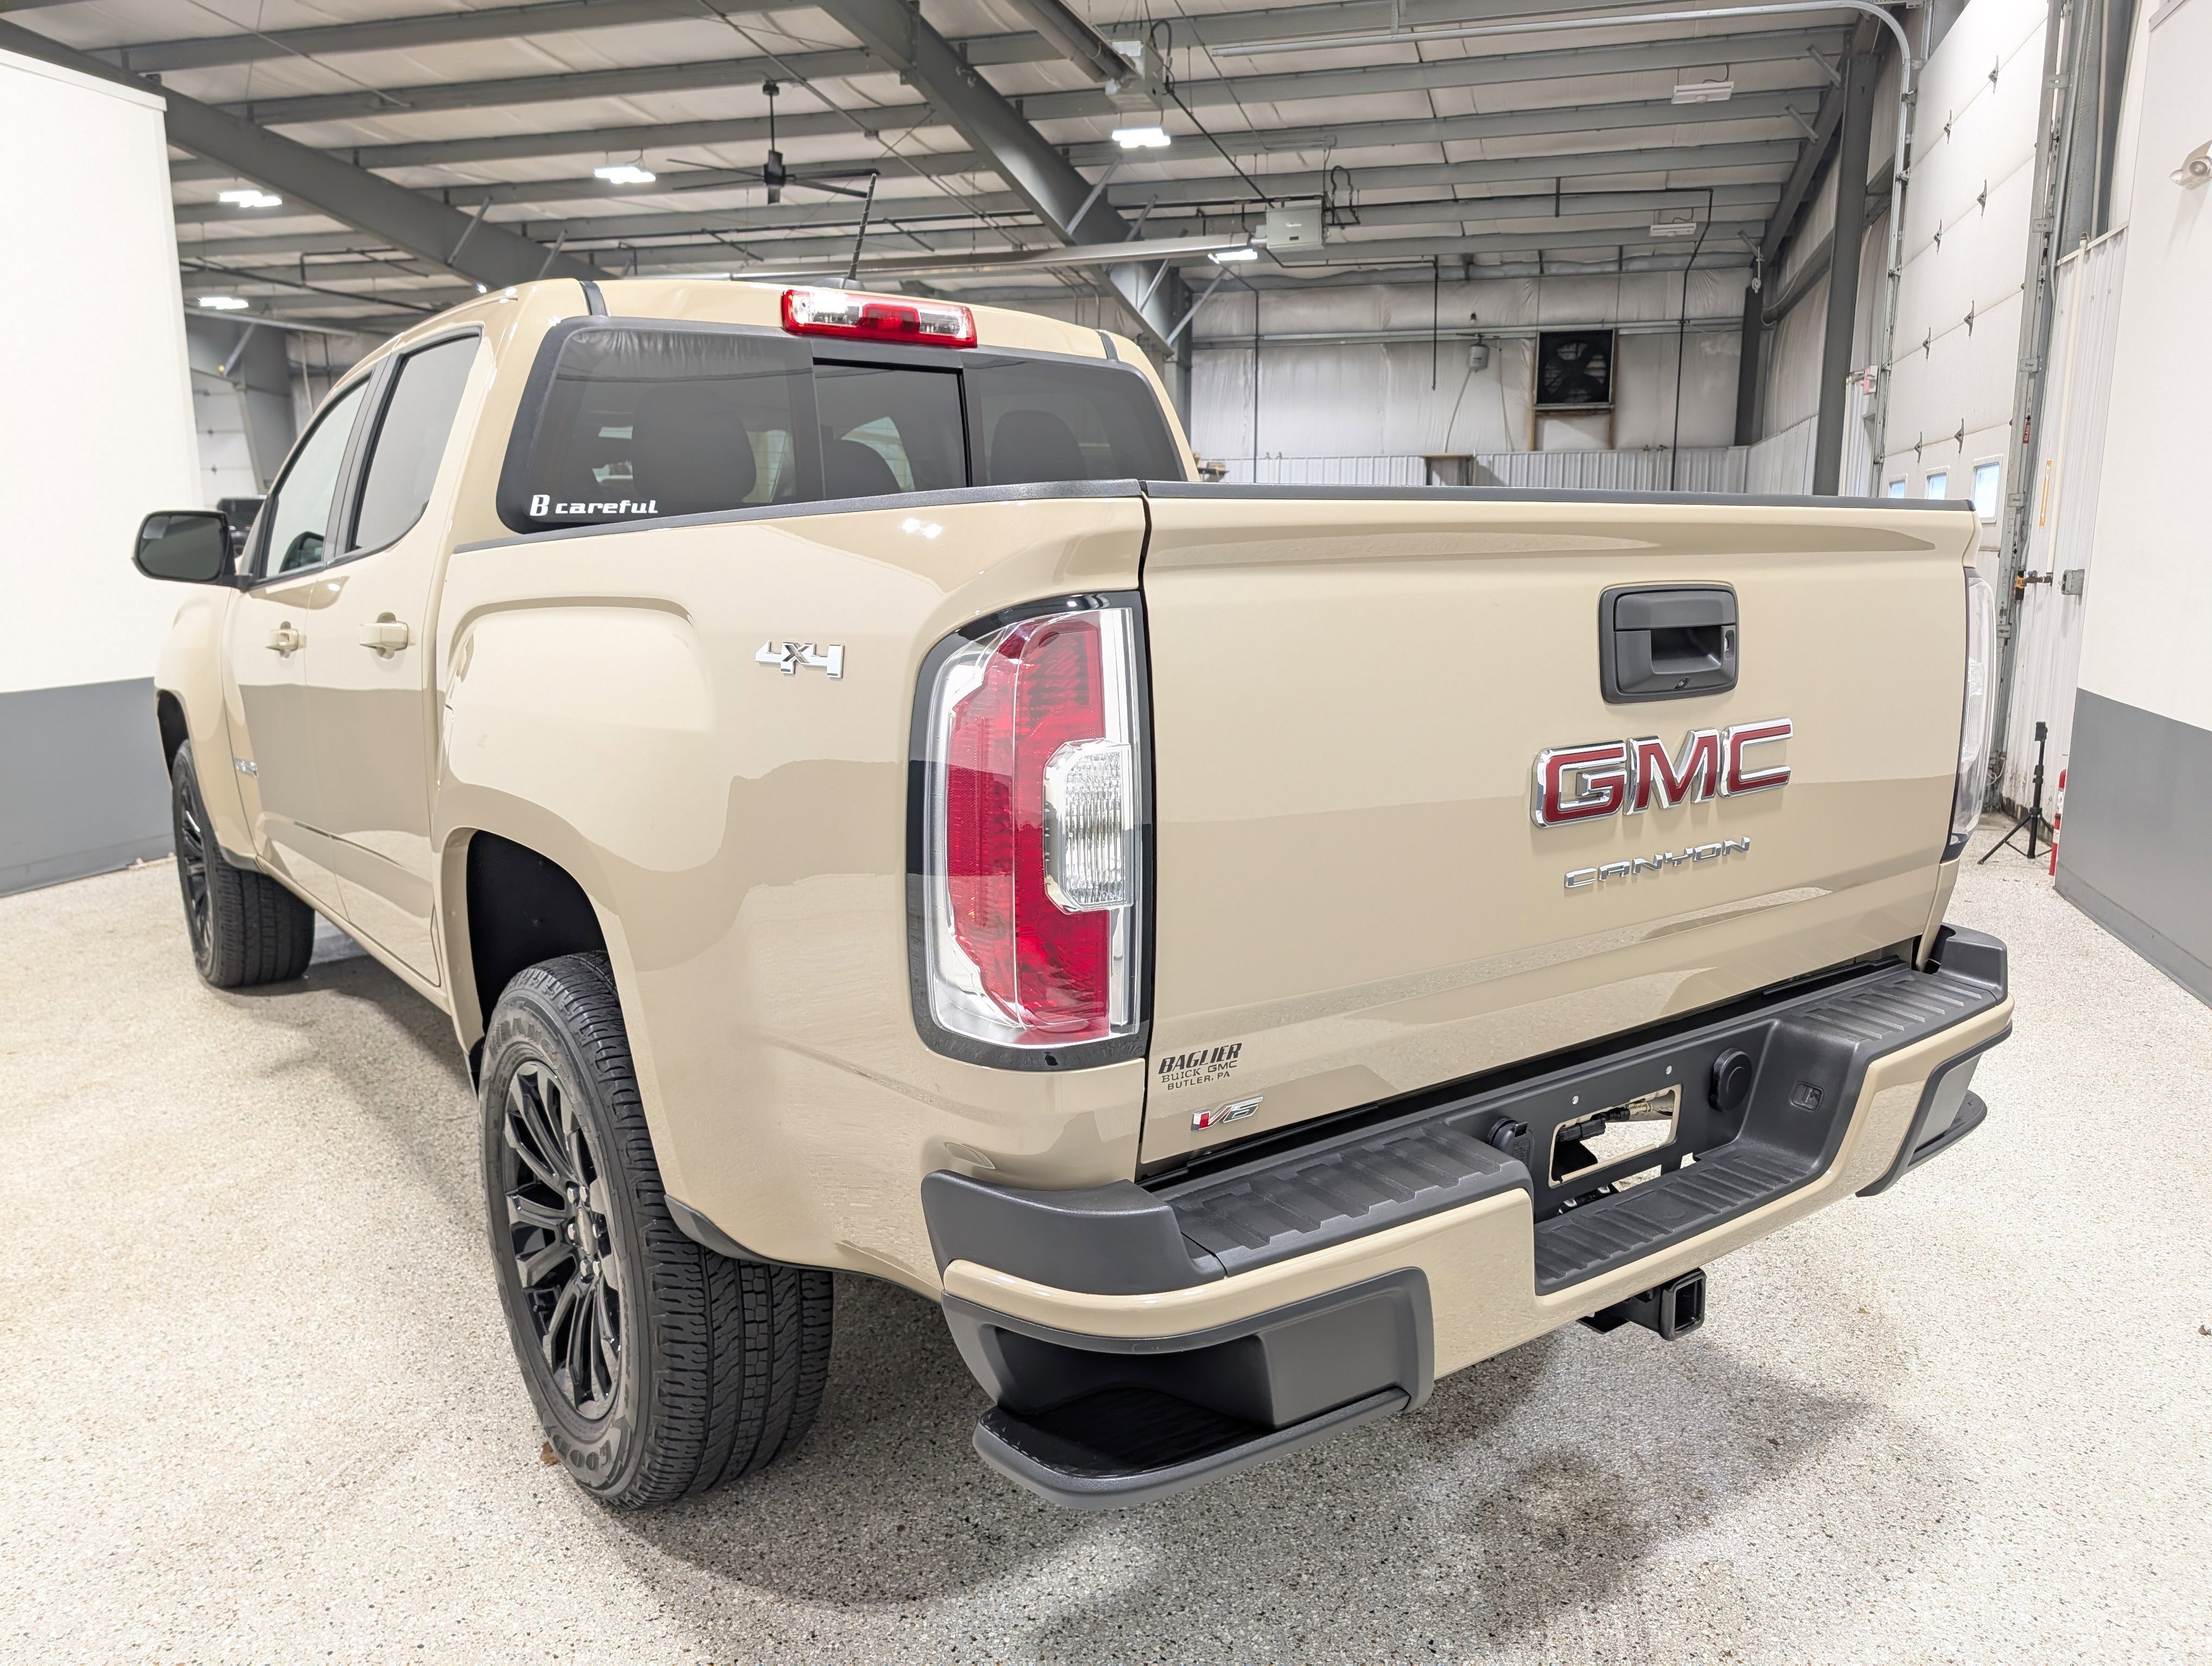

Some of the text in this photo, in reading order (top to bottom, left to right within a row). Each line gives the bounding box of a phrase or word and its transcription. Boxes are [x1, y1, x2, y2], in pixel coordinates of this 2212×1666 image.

[530, 494, 658, 516] B careful
[1531, 717, 1793, 828] GMC
[1564, 836, 1750, 888] CANYON
[1158, 1042, 1242, 1074] BAGLIER
[1161, 1060, 1238, 1083] BUICK GMC
[1167, 1071, 1230, 1090] BUTLER, PA
[1191, 1095, 1264, 1131] V6
